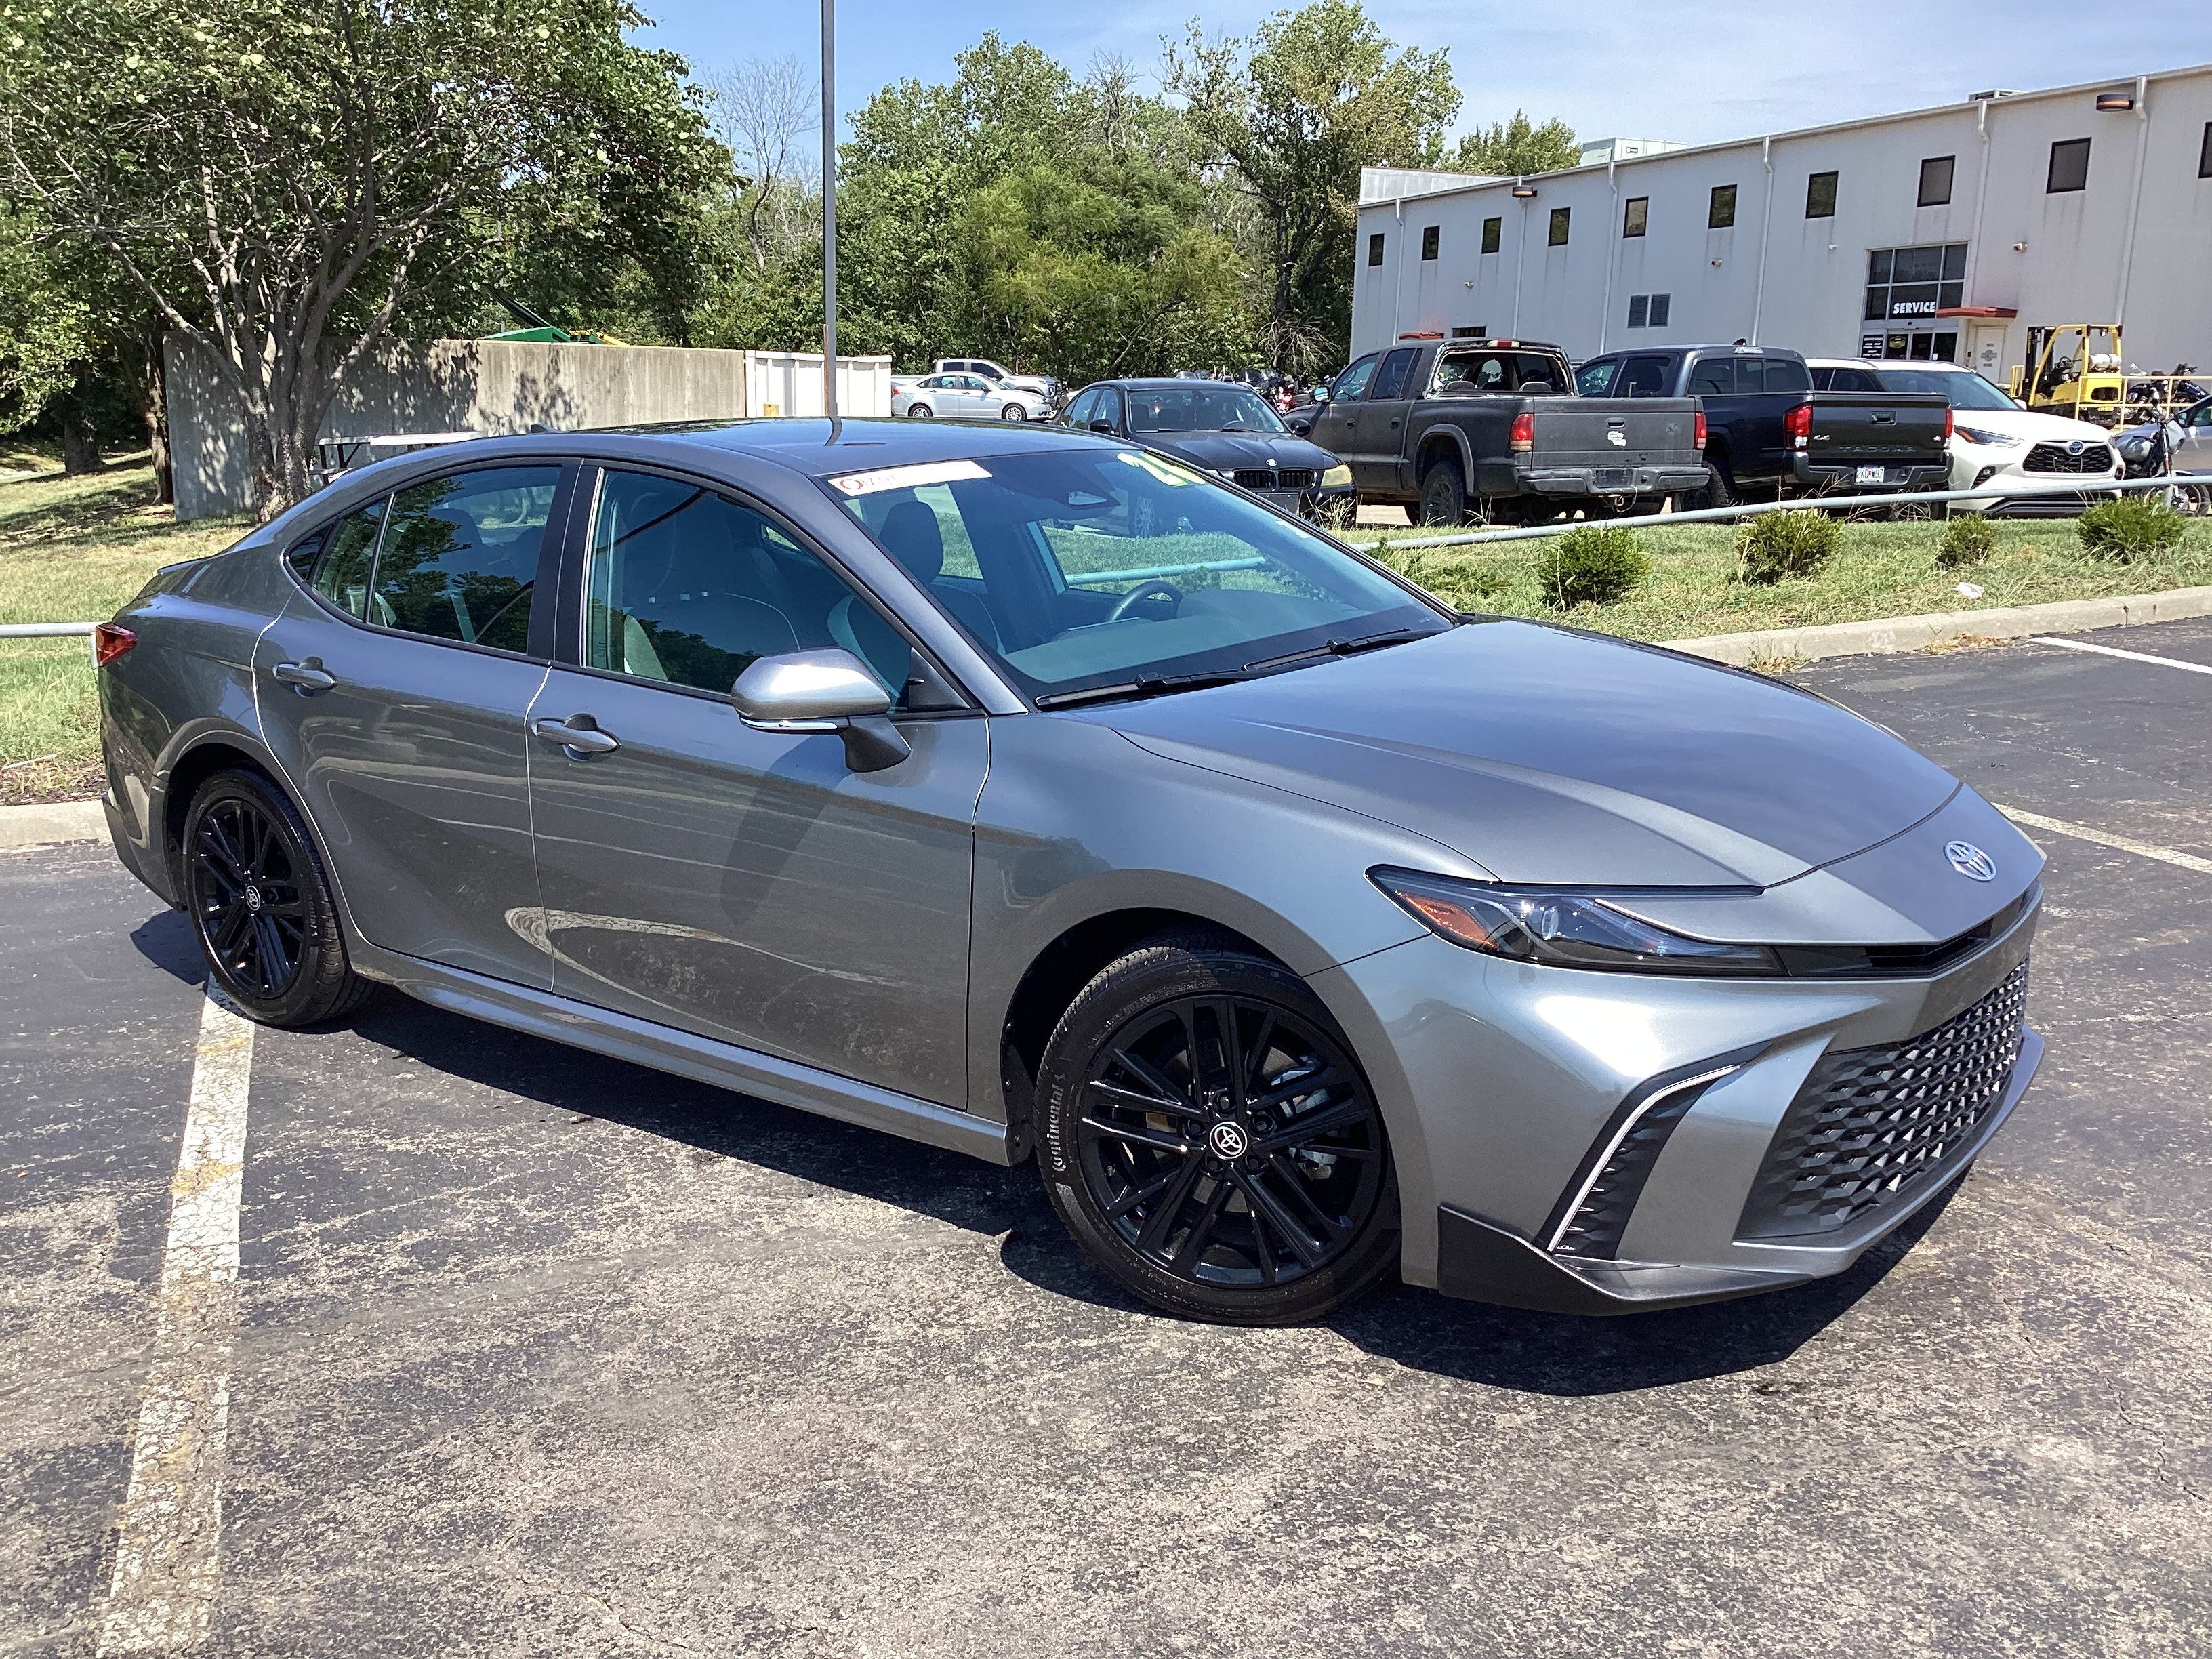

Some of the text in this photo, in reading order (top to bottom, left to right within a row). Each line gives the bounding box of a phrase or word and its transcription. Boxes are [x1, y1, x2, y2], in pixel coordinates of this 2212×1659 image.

[1893, 301, 1936, 314] SERVICE
[1839, 445, 1917, 453] TACOMA
[1046, 1084, 1067, 1172] Continental
